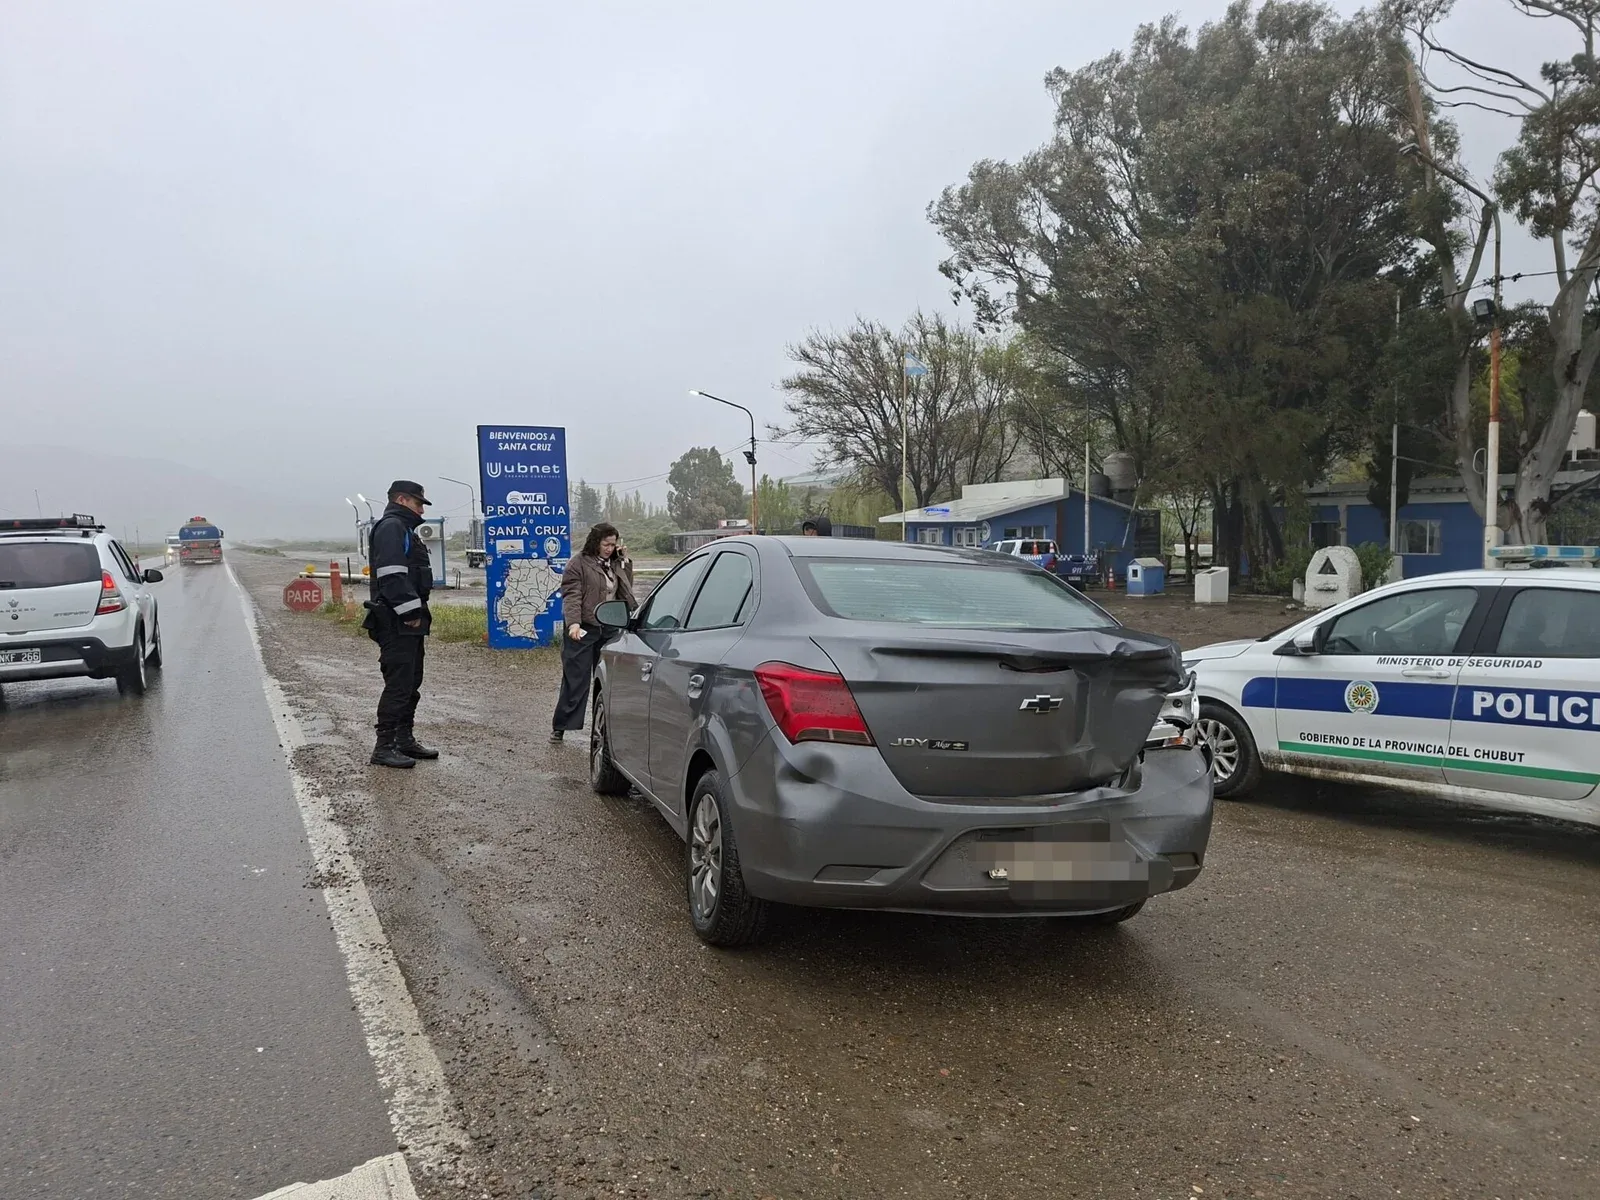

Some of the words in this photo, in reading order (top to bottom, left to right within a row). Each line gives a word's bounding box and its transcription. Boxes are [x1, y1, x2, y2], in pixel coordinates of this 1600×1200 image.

[489, 431, 548, 441] BIENVENIDOS
[549, 433, 556, 441] A
[498, 442, 528, 451] SANTA
[529, 443, 552, 452] CRUZ
[504, 462, 560, 473] ubnet
[486, 505, 566, 516] PROVINCIA
[521, 517, 534, 525] de
[488, 526, 529, 536] SANTA
[534, 525, 568, 536] CRUZ
[287, 589, 321, 603] PARE
[21, 651, 39, 662] 266
[1376, 656, 1445, 667] MINISTERIO
[1447, 657, 1465, 667] DE
[1467, 658, 1543, 669] SEGURIDAD
[889, 737, 929, 747] JOY
[1299, 732, 1350, 746] GOBIERNO
[1352, 737, 1366, 747] DE
[1368, 738, 1382, 749] LA
[1384, 739, 1445, 755] PROVINCIA
[1448, 745, 1470, 758] DEL
[1473, 748, 1526, 763] CHUBUT
